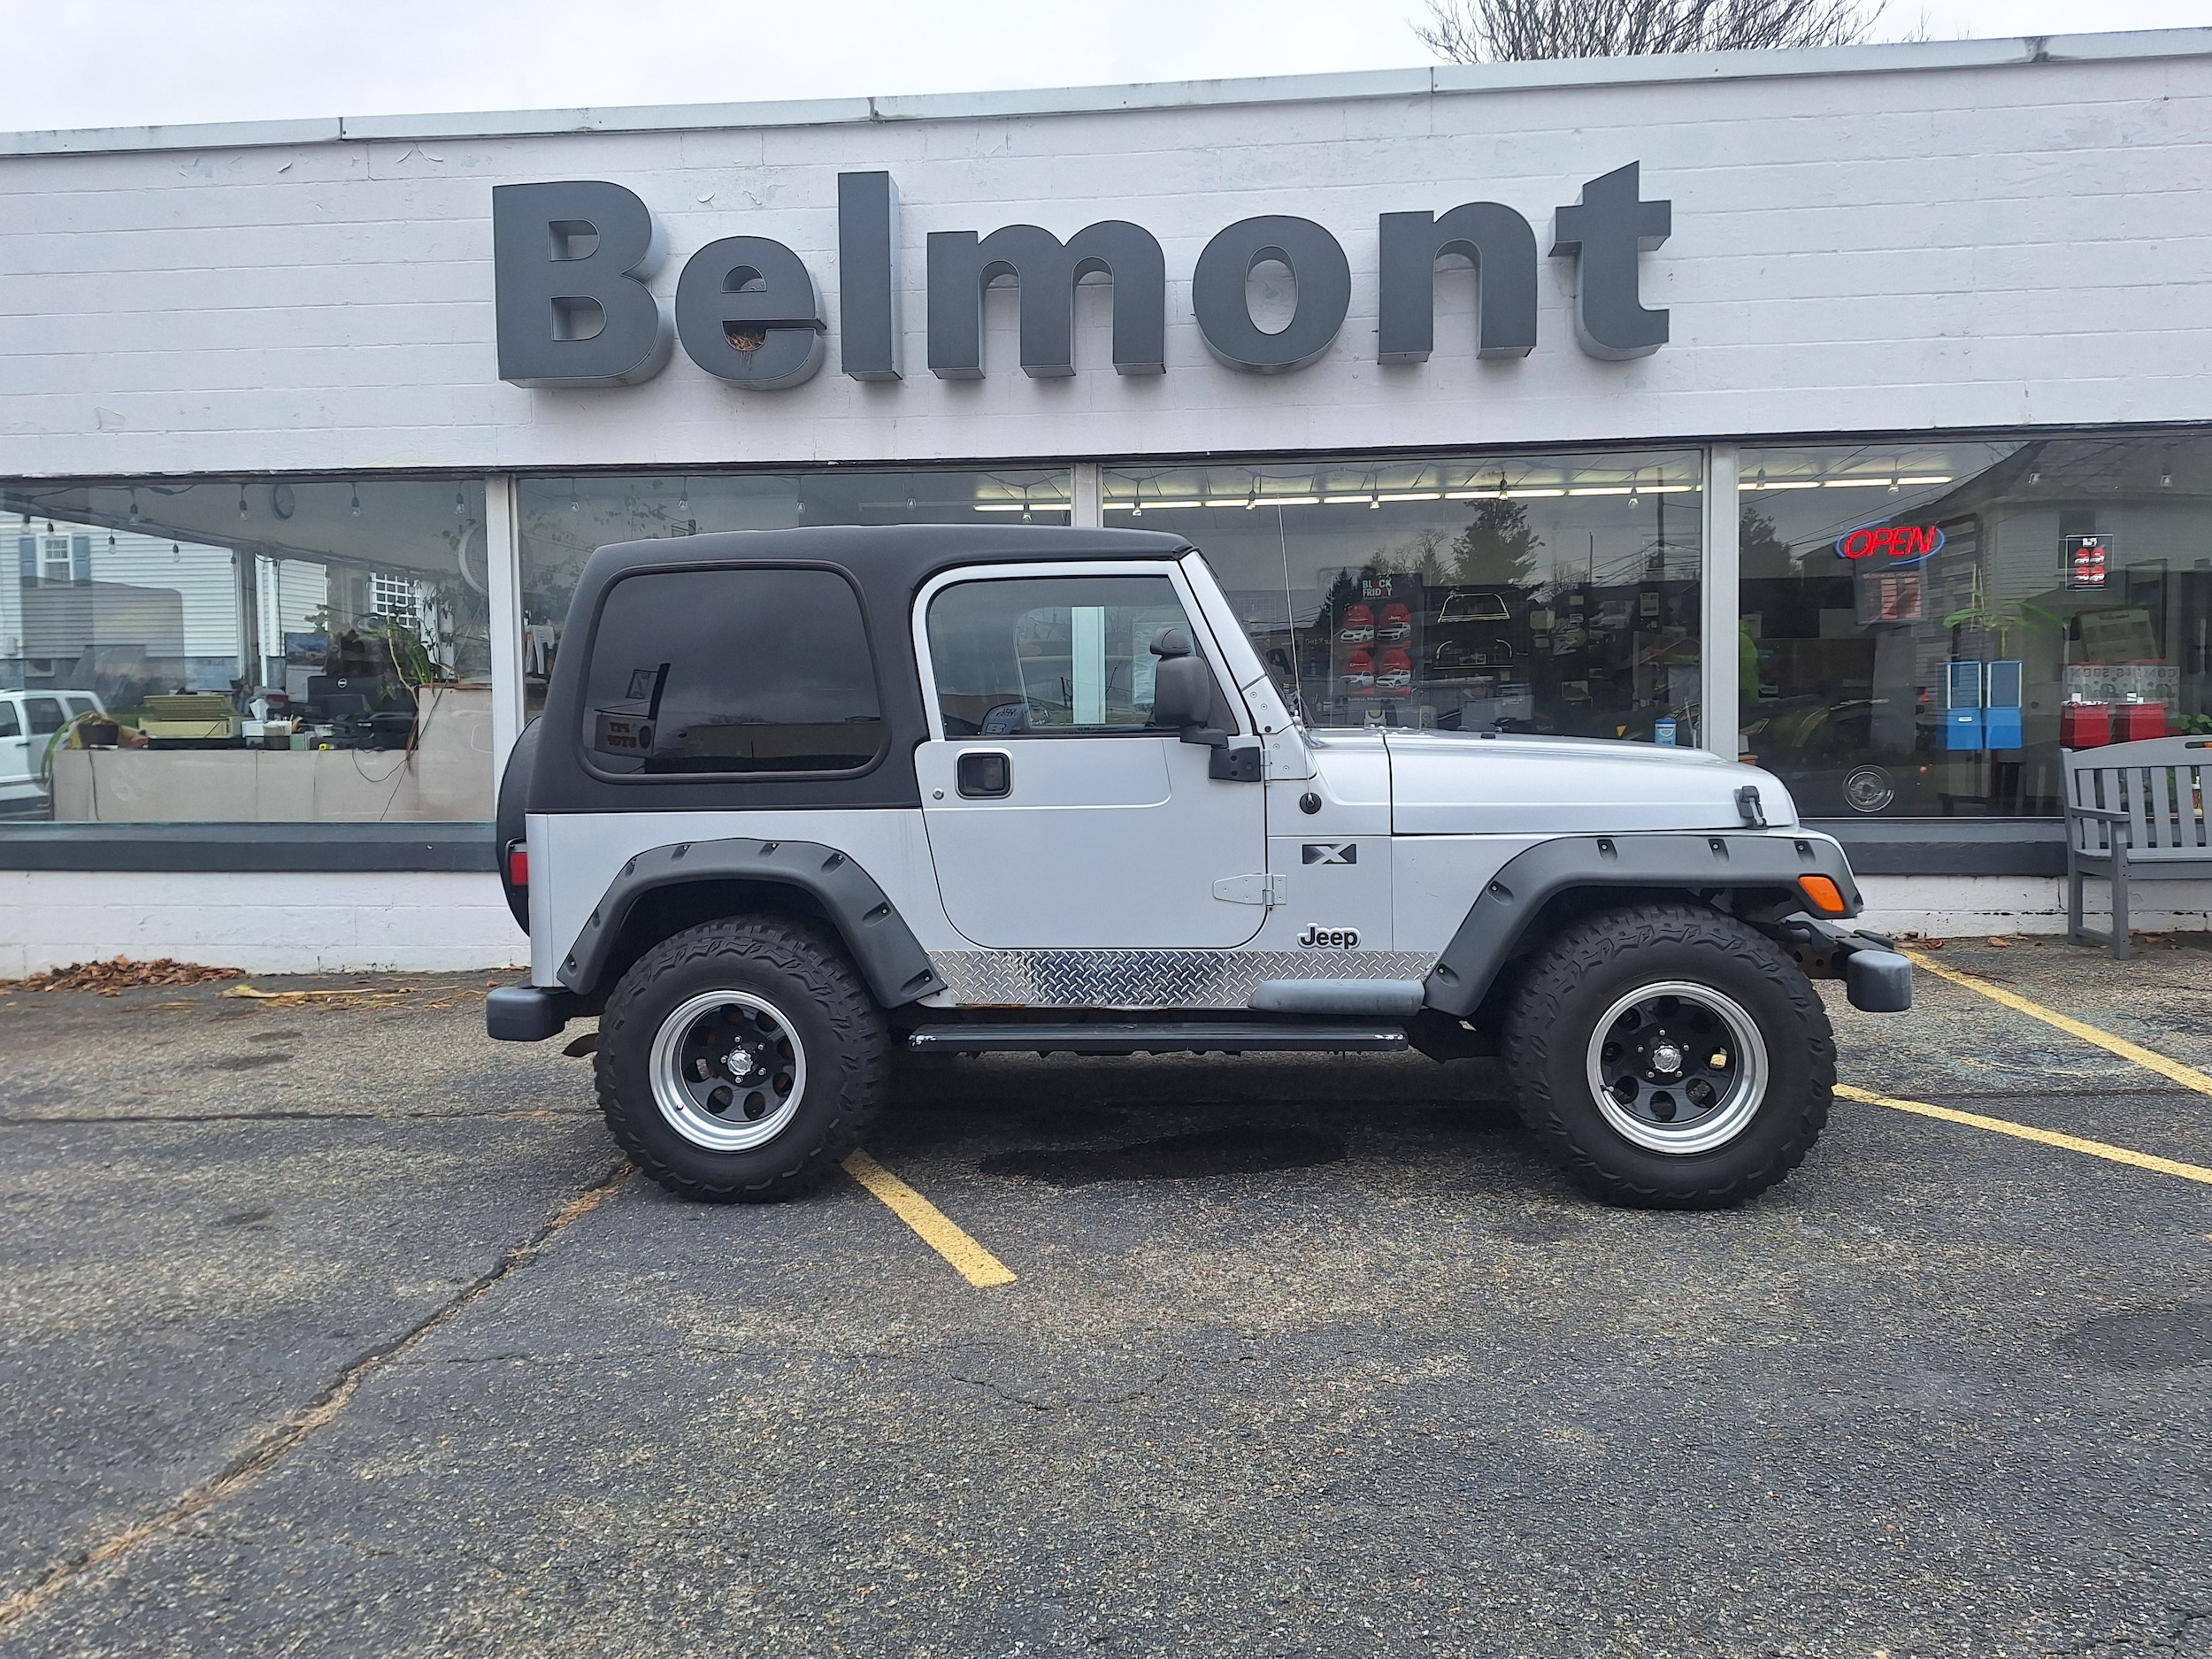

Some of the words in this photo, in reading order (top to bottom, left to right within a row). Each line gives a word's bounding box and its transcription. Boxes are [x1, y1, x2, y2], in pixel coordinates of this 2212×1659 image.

[492, 159, 1671, 389] Belmont
[1845, 526, 1936, 559] OPEN
[1309, 843, 1355, 864] X
[1300, 926, 1358, 949] Jeep
